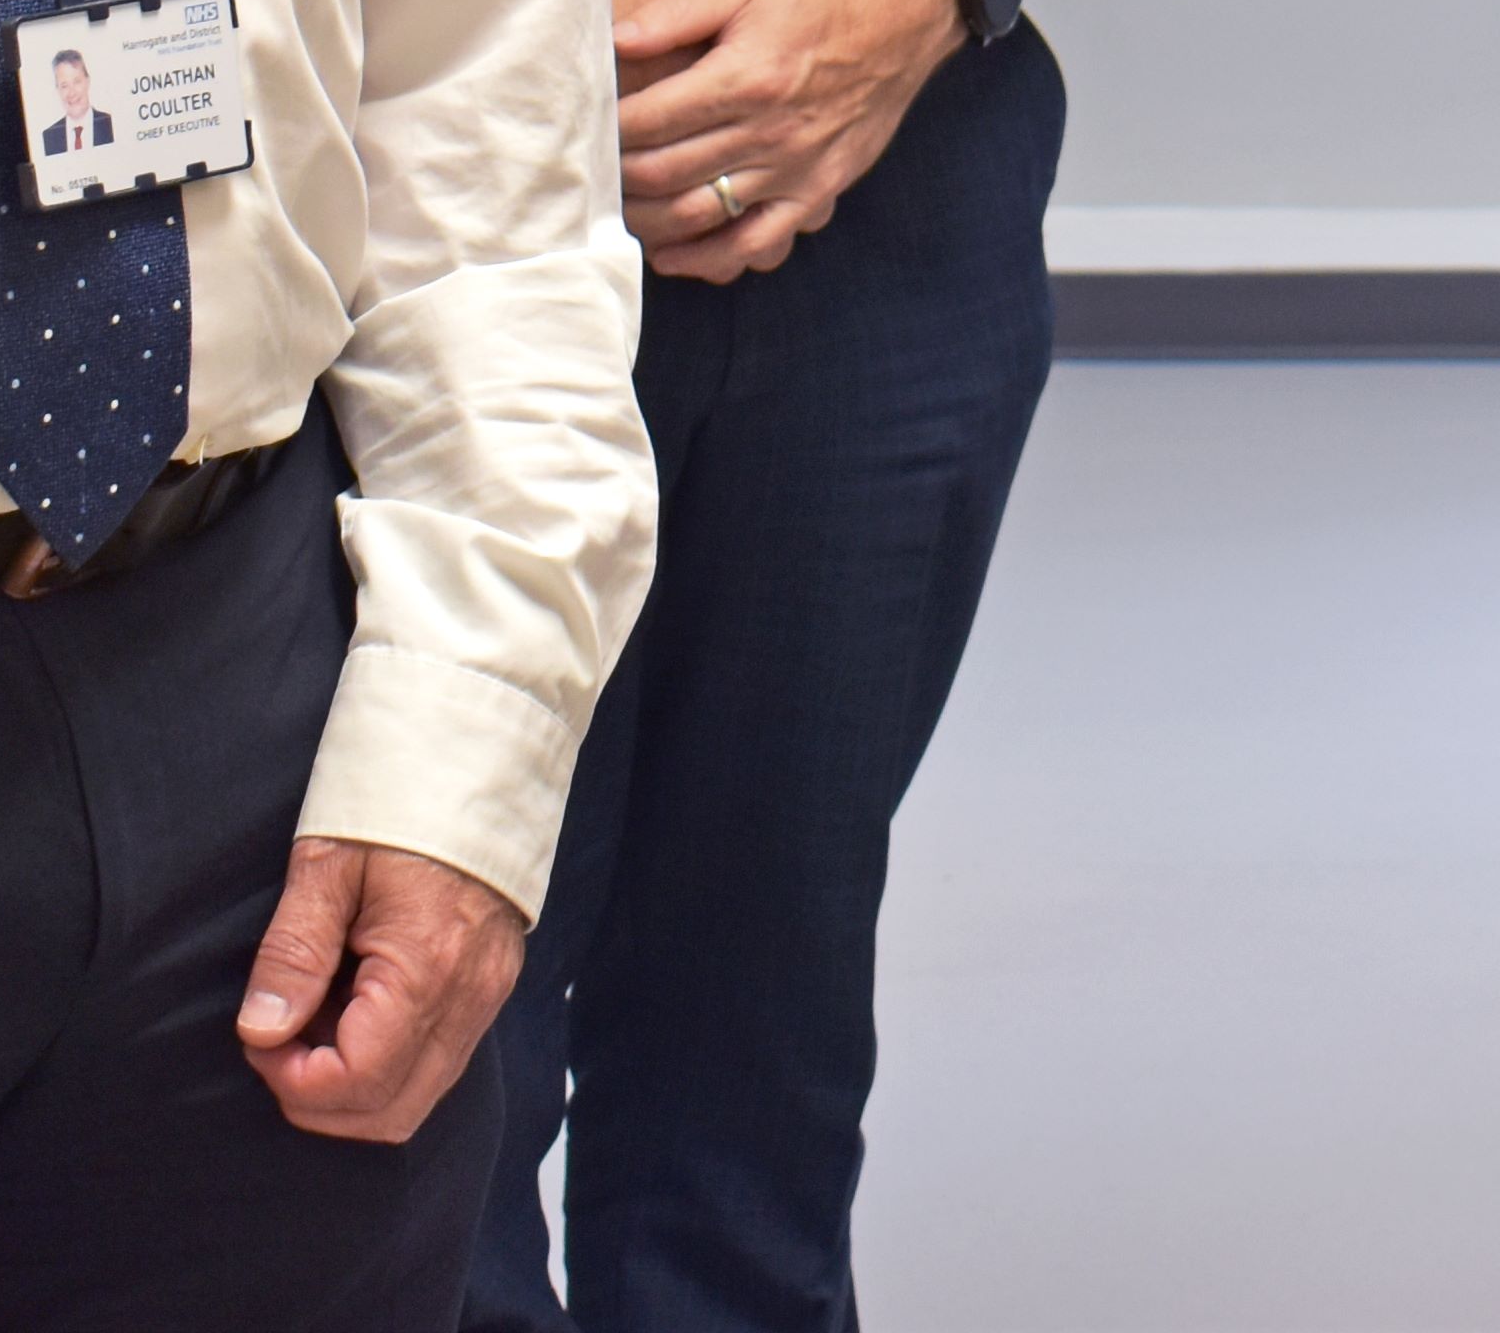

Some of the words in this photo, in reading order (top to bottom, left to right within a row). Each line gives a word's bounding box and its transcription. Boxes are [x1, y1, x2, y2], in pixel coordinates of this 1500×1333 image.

[186, 3, 218, 24] NHS
[122, 32, 168, 52] Harrogate
[170, 30, 187, 43] and
[190, 25, 220, 40] District
[131, 64, 216, 95] JONATHAN
[138, 92, 213, 120] COULTER
[137, 126, 164, 141] CHIEF
[168, 116, 220, 136] EXECUTIVE
